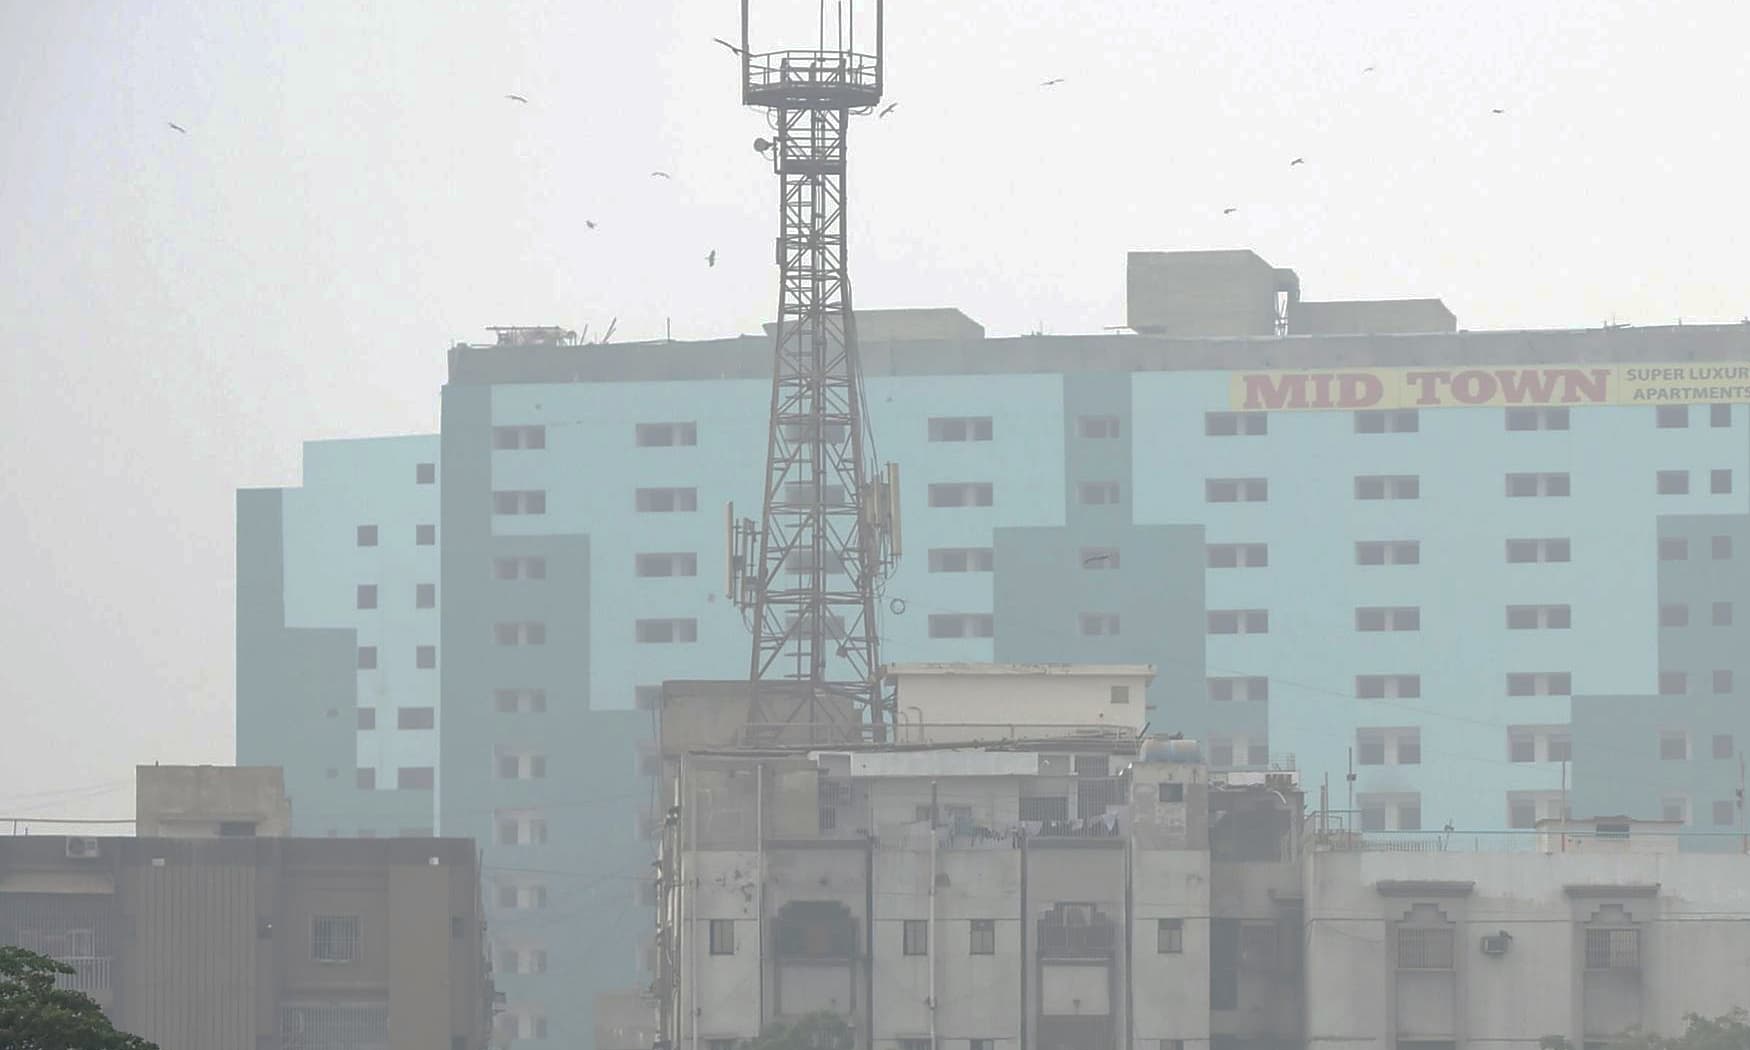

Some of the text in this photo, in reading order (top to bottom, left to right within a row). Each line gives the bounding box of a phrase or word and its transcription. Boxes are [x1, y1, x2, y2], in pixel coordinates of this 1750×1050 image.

[1242, 368, 1612, 409] MID TOWN
[1626, 368, 1684, 382] SUPER
